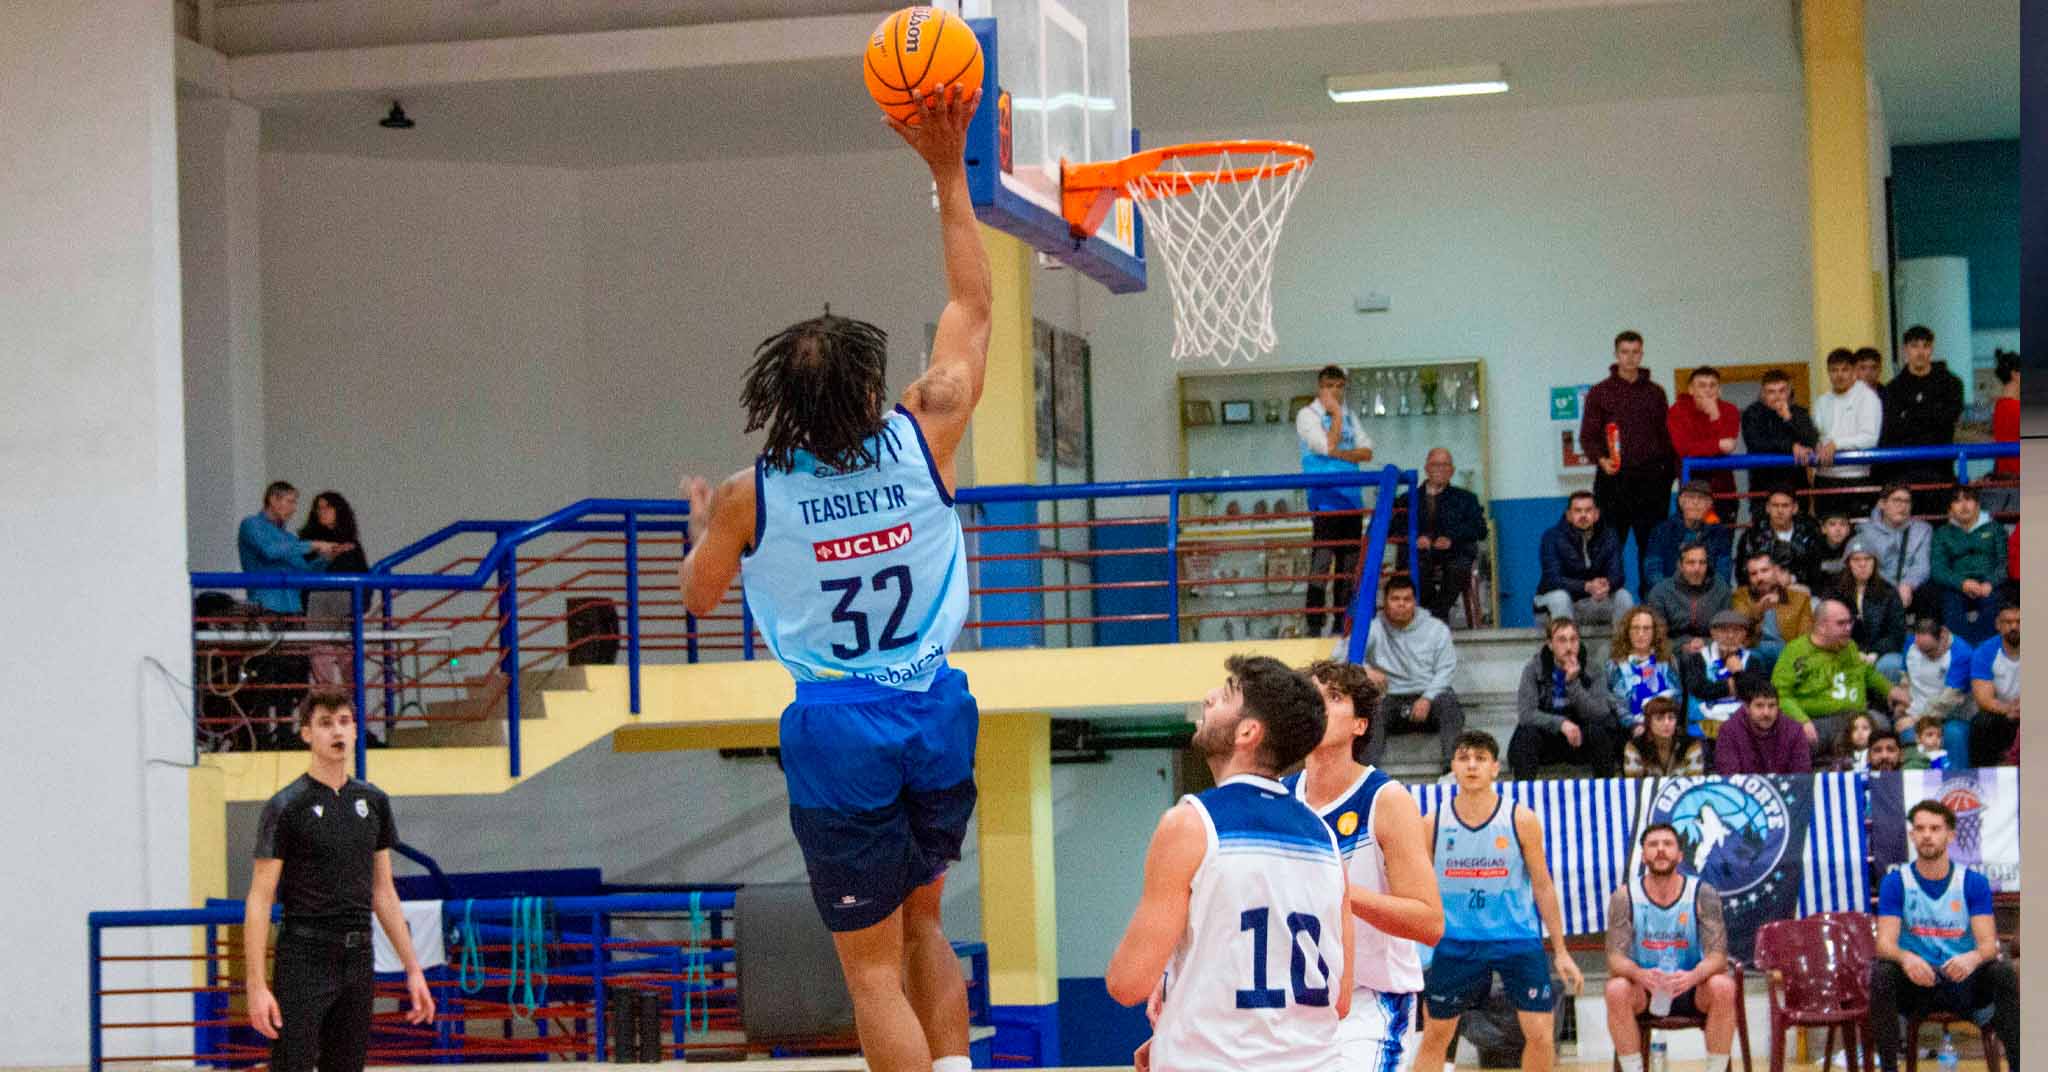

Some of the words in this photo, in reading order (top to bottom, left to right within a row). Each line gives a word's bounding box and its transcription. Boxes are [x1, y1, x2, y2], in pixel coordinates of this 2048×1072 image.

[798, 487, 878, 525] TEASLEY
[882, 483, 908, 511] JR
[833, 526, 911, 559] UCLM
[820, 564, 919, 661] 32
[1468, 888, 1486, 911] 26
[1235, 906, 1331, 1009] 10
